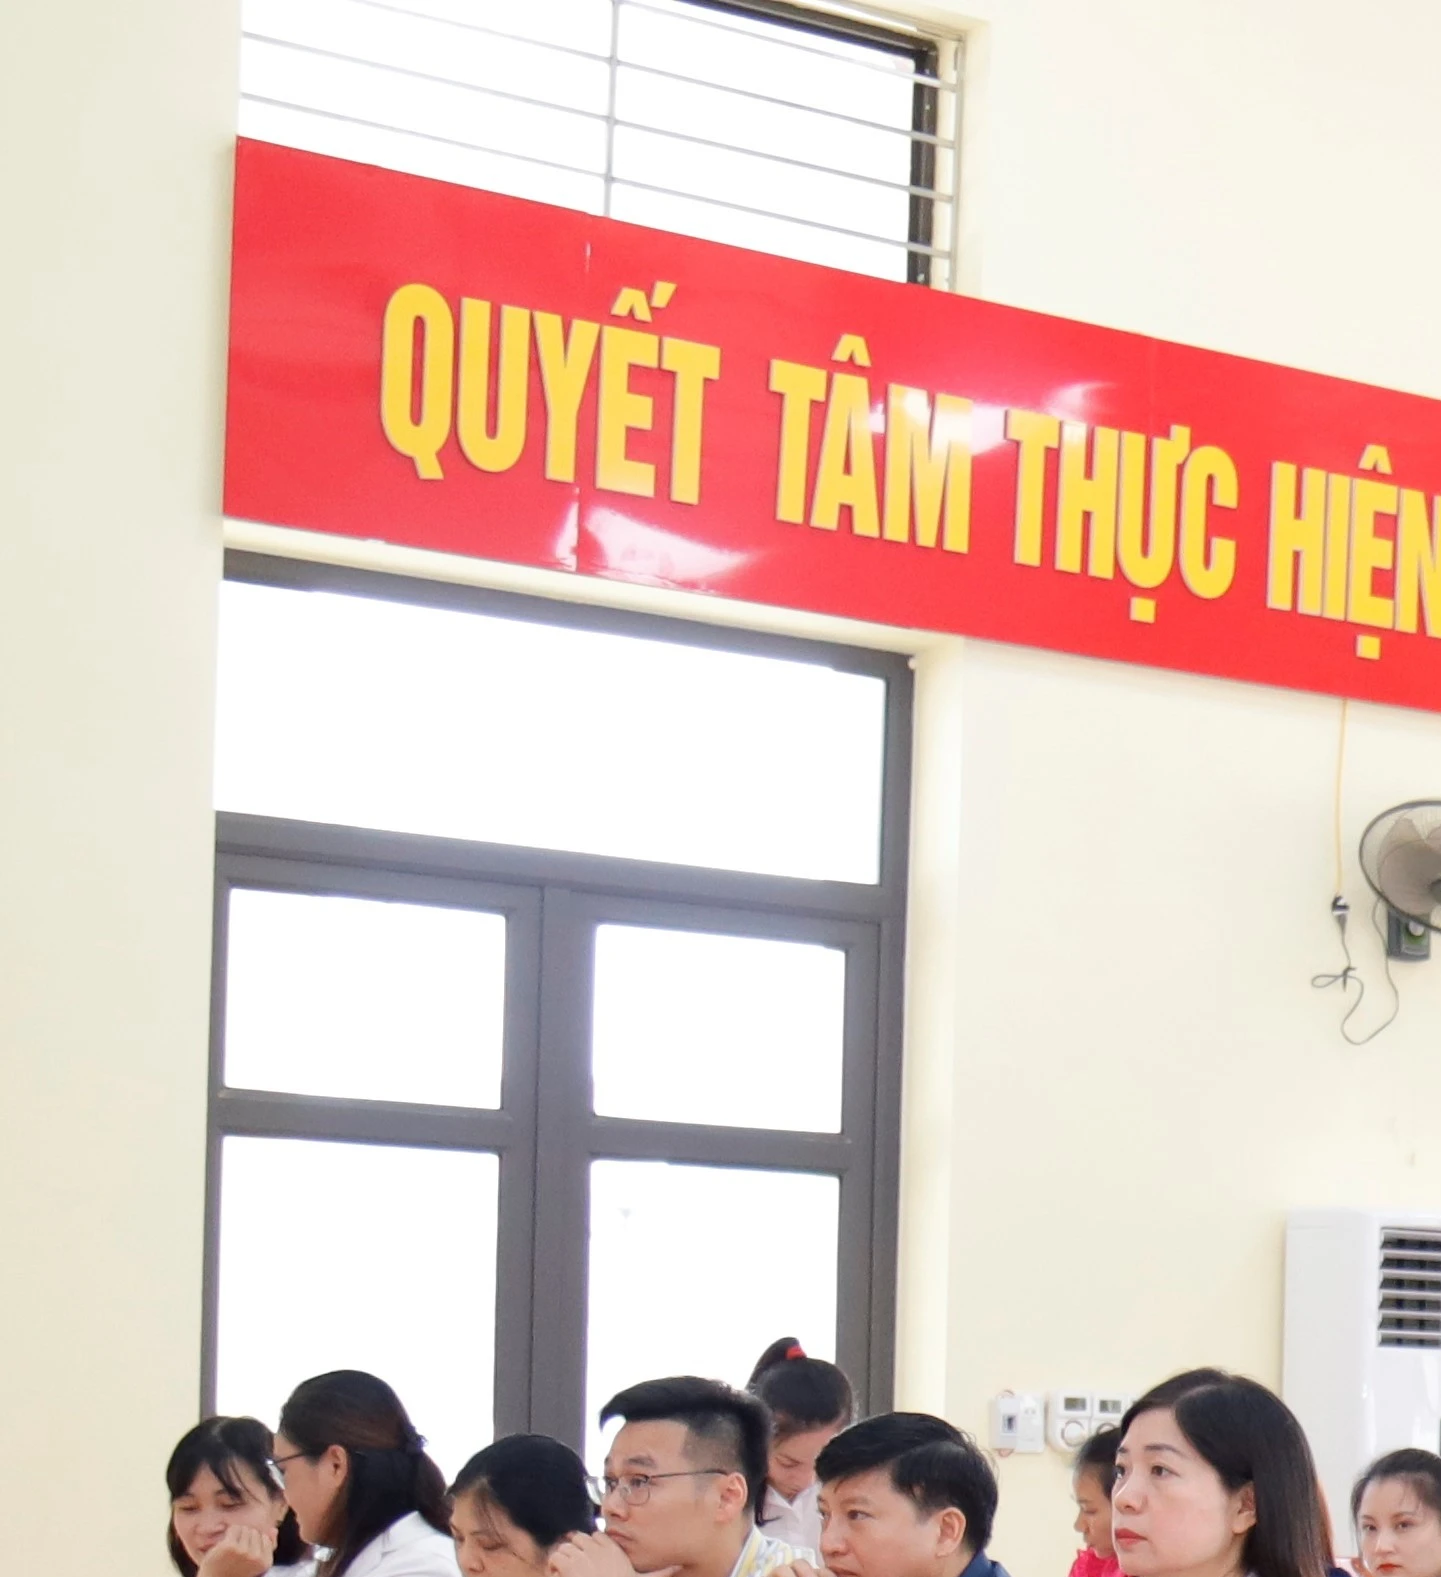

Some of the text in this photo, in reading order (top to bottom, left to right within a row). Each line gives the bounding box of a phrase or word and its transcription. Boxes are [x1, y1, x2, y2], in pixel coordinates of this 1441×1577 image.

[381, 280, 722, 505] QUYẾT
[770, 333, 974, 554] TÂM
[1008, 408, 1240, 623] THỰC
